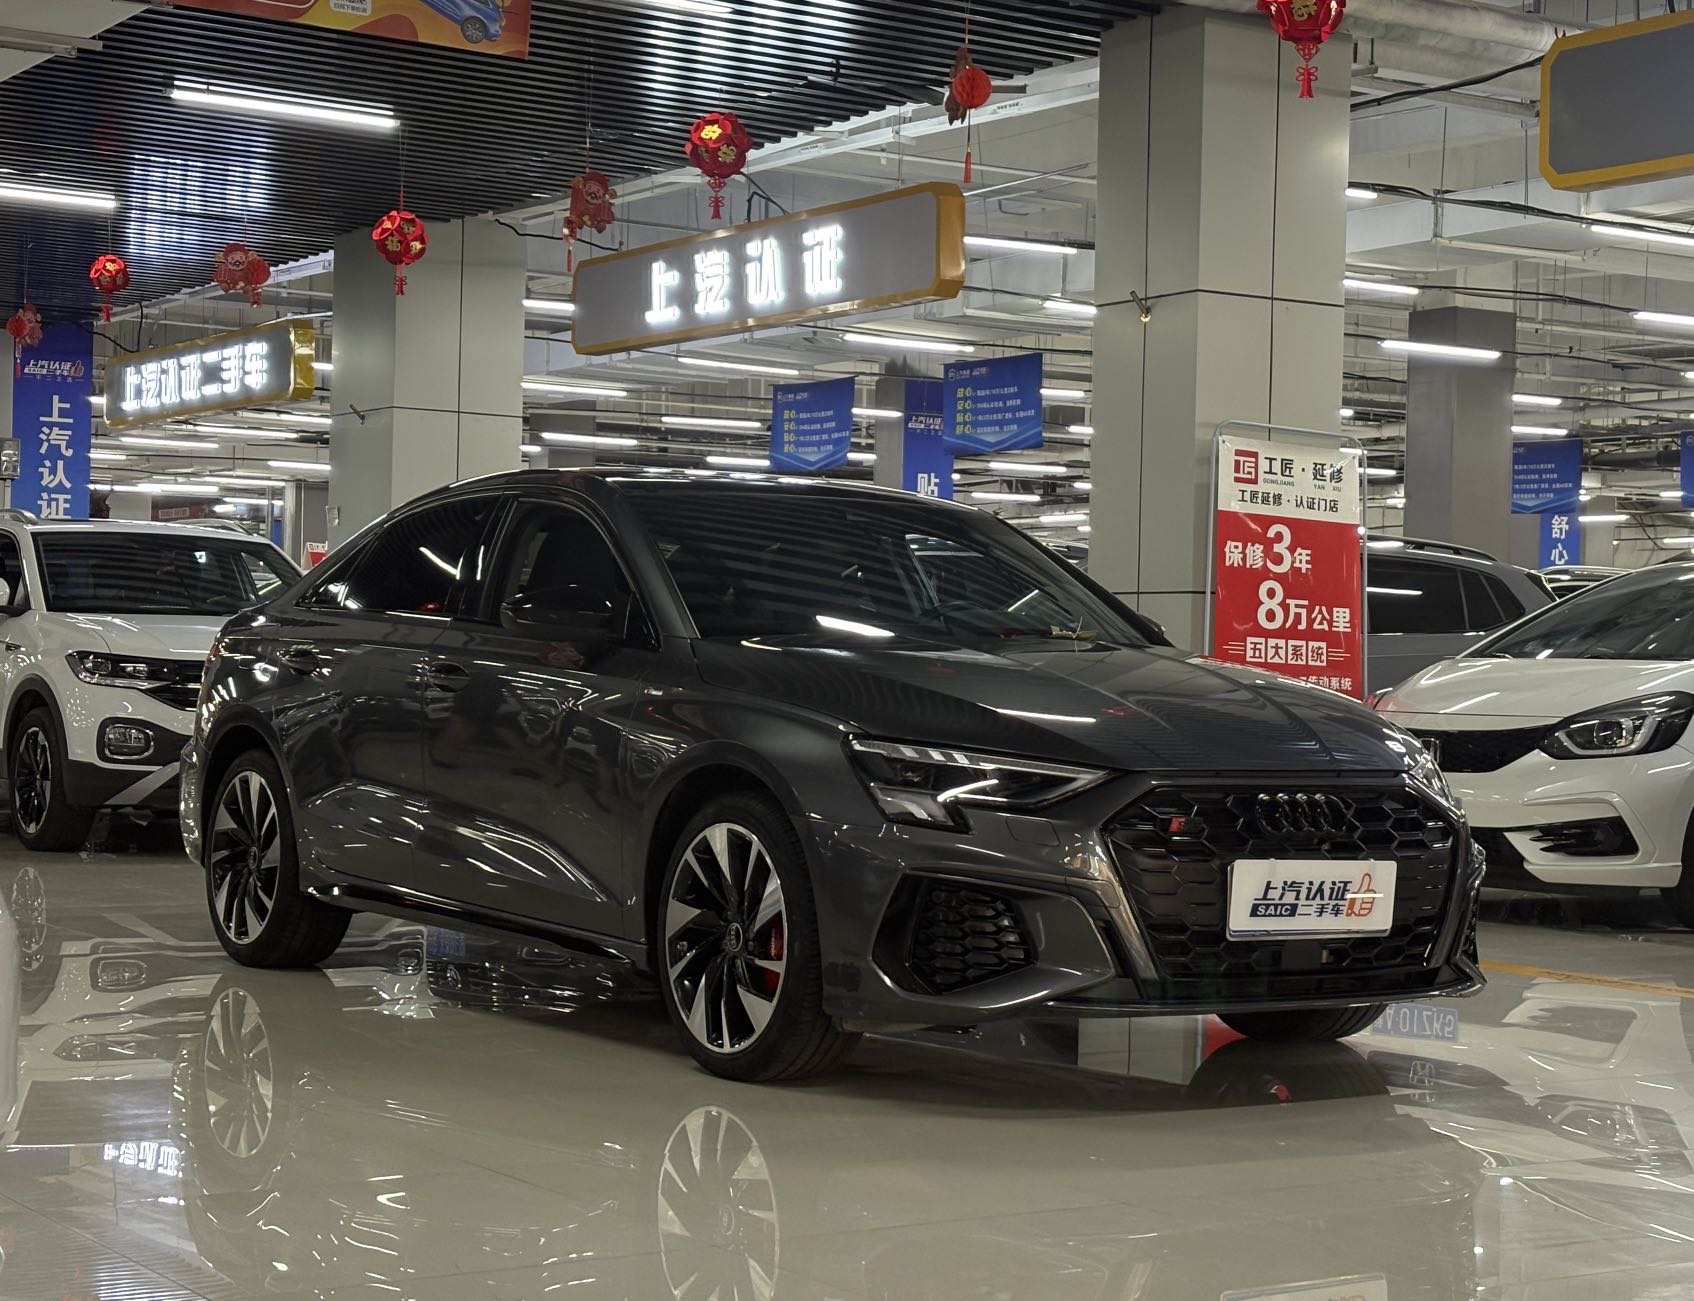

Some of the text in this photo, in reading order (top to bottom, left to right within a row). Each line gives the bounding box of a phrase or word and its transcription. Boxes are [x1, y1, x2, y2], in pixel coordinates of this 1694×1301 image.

[644, 223, 844, 324] 上汽认证
[29, 359, 73, 370] 上汽认证
[121, 341, 268, 411] 上汽认证二手车
[37, 394, 74, 519] 上汽认证
[917, 472, 940, 497] 贴
[1262, 478, 1295, 487] GONGJIANG
[1313, 483, 1325, 491] YAN
[1224, 523, 1312, 574] 保修3年
[1550, 514, 1569, 565] 舒心
[1257, 579, 1352, 632] 8万公里
[1248, 640, 1326, 665] 五大系统
[1253, 880, 1353, 902] 上汽认证
[1256, 903, 1346, 917] SAIC 二手车
